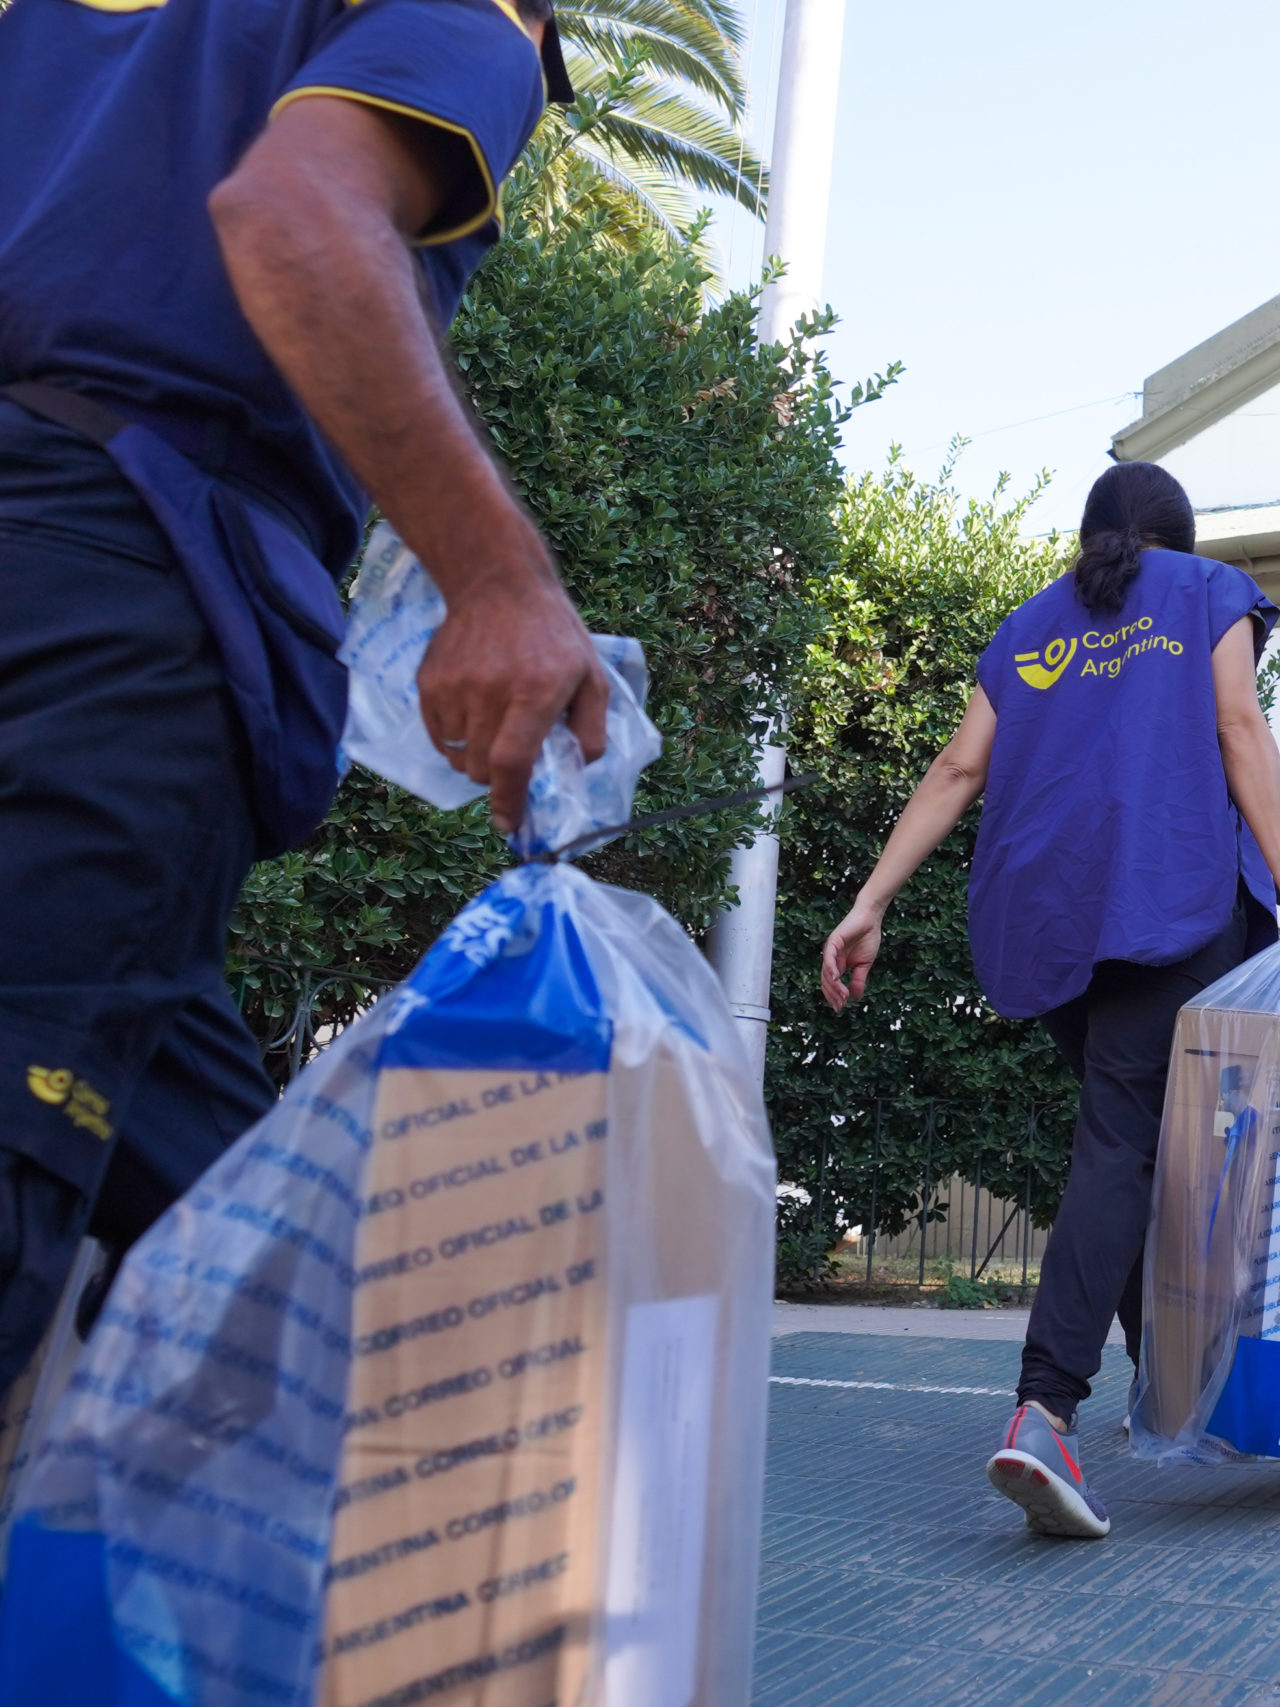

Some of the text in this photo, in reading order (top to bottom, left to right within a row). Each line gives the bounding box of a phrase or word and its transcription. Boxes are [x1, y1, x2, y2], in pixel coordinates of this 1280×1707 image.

[1080, 634, 1184, 678] Argntino
[380, 1099, 477, 1141] OFICIAL
[481, 1084, 515, 1109] DE
[519, 1071, 552, 1096] LA
[409, 1154, 506, 1200] OFICIAL
[510, 1141, 544, 1169] DE
[549, 1131, 580, 1156] LA
[438, 1214, 536, 1260] OFICIAL
[538, 1197, 571, 1228] DE
[355, 1303, 464, 1357] CORREO
[467, 1273, 563, 1320] OFICIAL
[565, 1257, 598, 1288] DE
[383, 1364, 493, 1419] CORREO
[497, 1335, 588, 1380] OFICIAL
[415, 1425, 520, 1480] CORREO
[445, 1489, 548, 1541] CORREO
[331, 1589, 471, 1658] ARGENTINA
